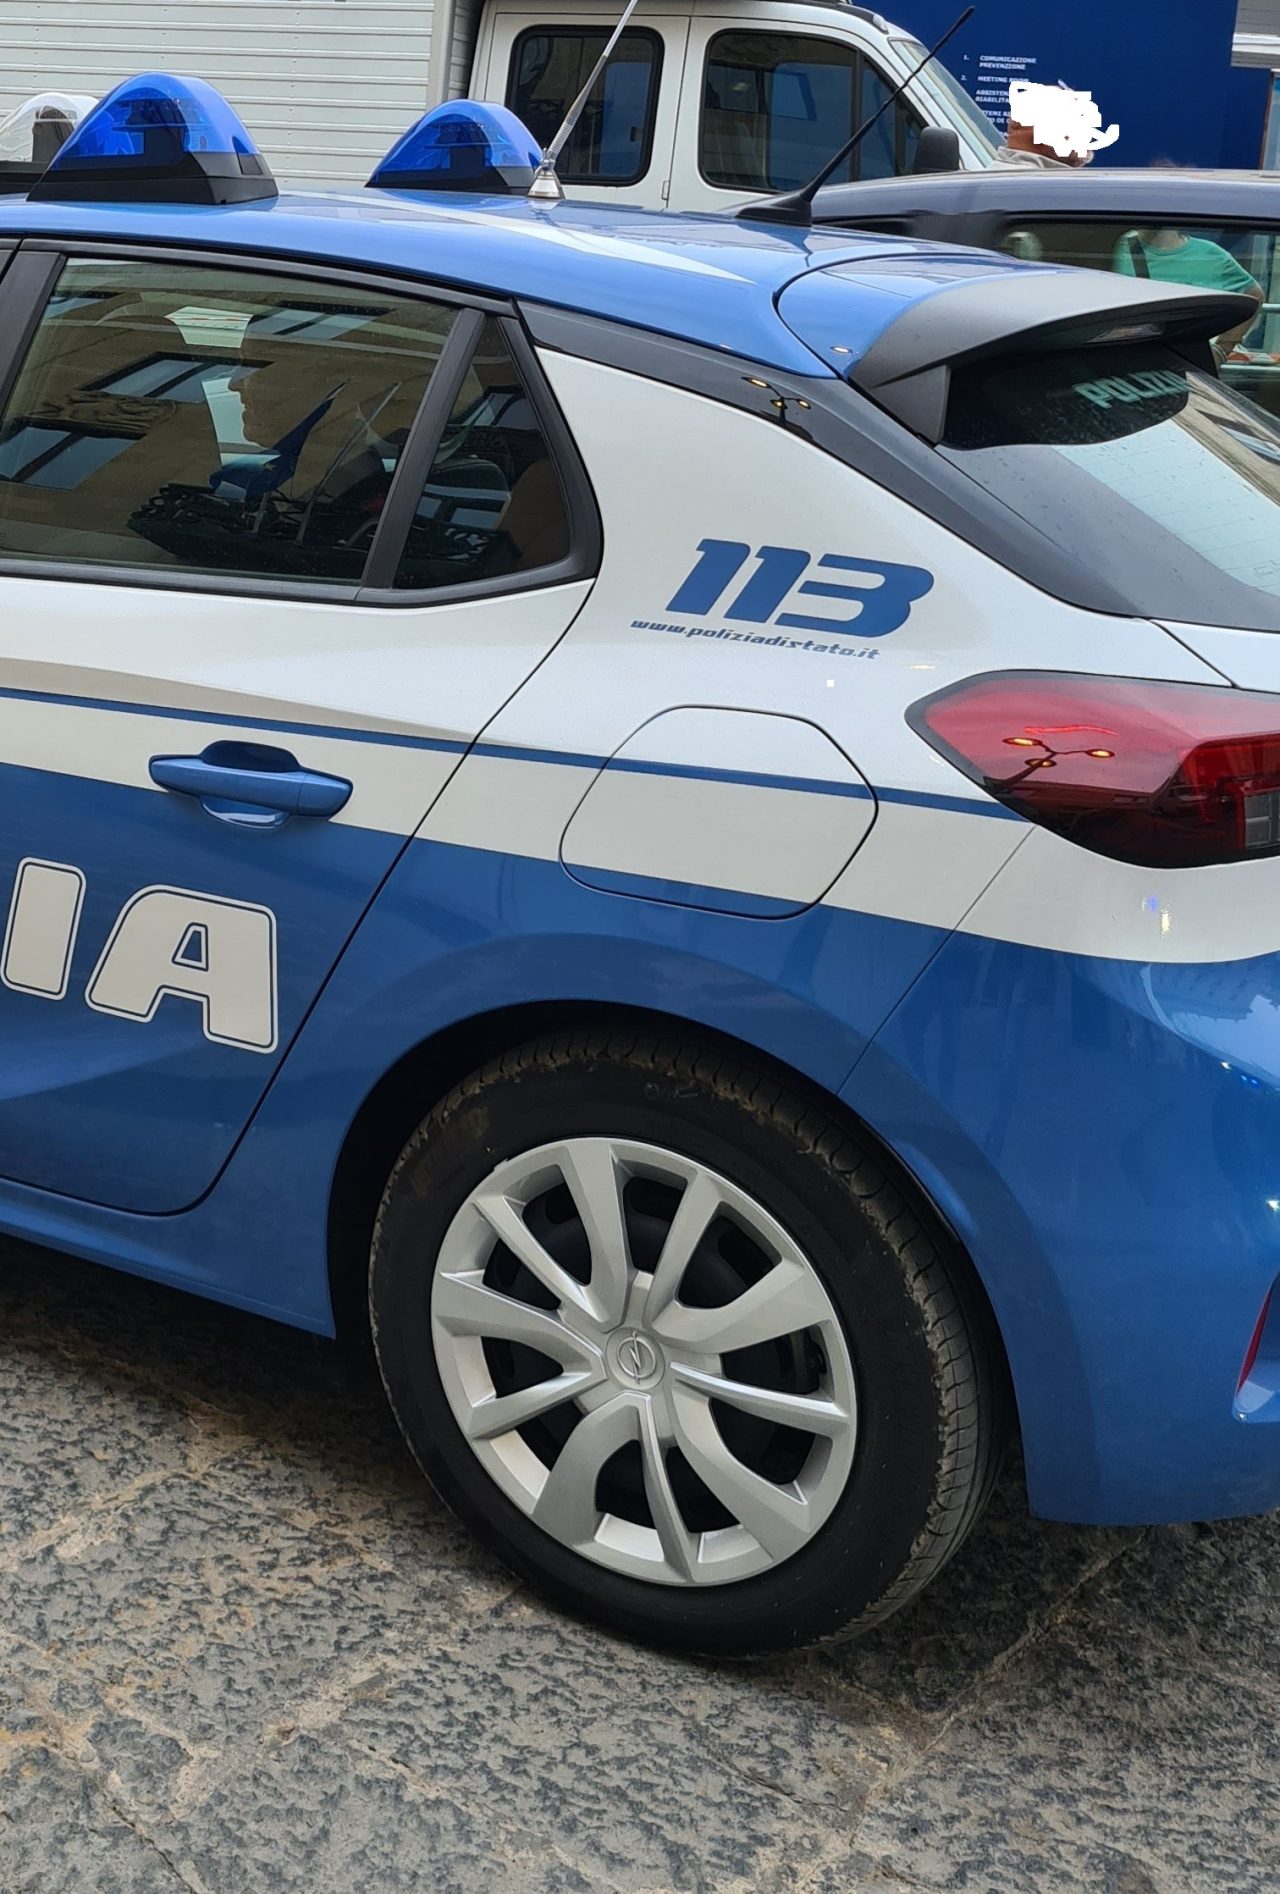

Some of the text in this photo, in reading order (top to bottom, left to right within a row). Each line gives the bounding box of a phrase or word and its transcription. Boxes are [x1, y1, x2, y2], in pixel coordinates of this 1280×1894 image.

[979, 55, 1037, 64] COMUNICAZIONE
[979, 62, 1026, 70] PREVENZIONE
[665, 538, 935, 638] 113
[629, 619, 880, 660] www.poliziadistato.it
